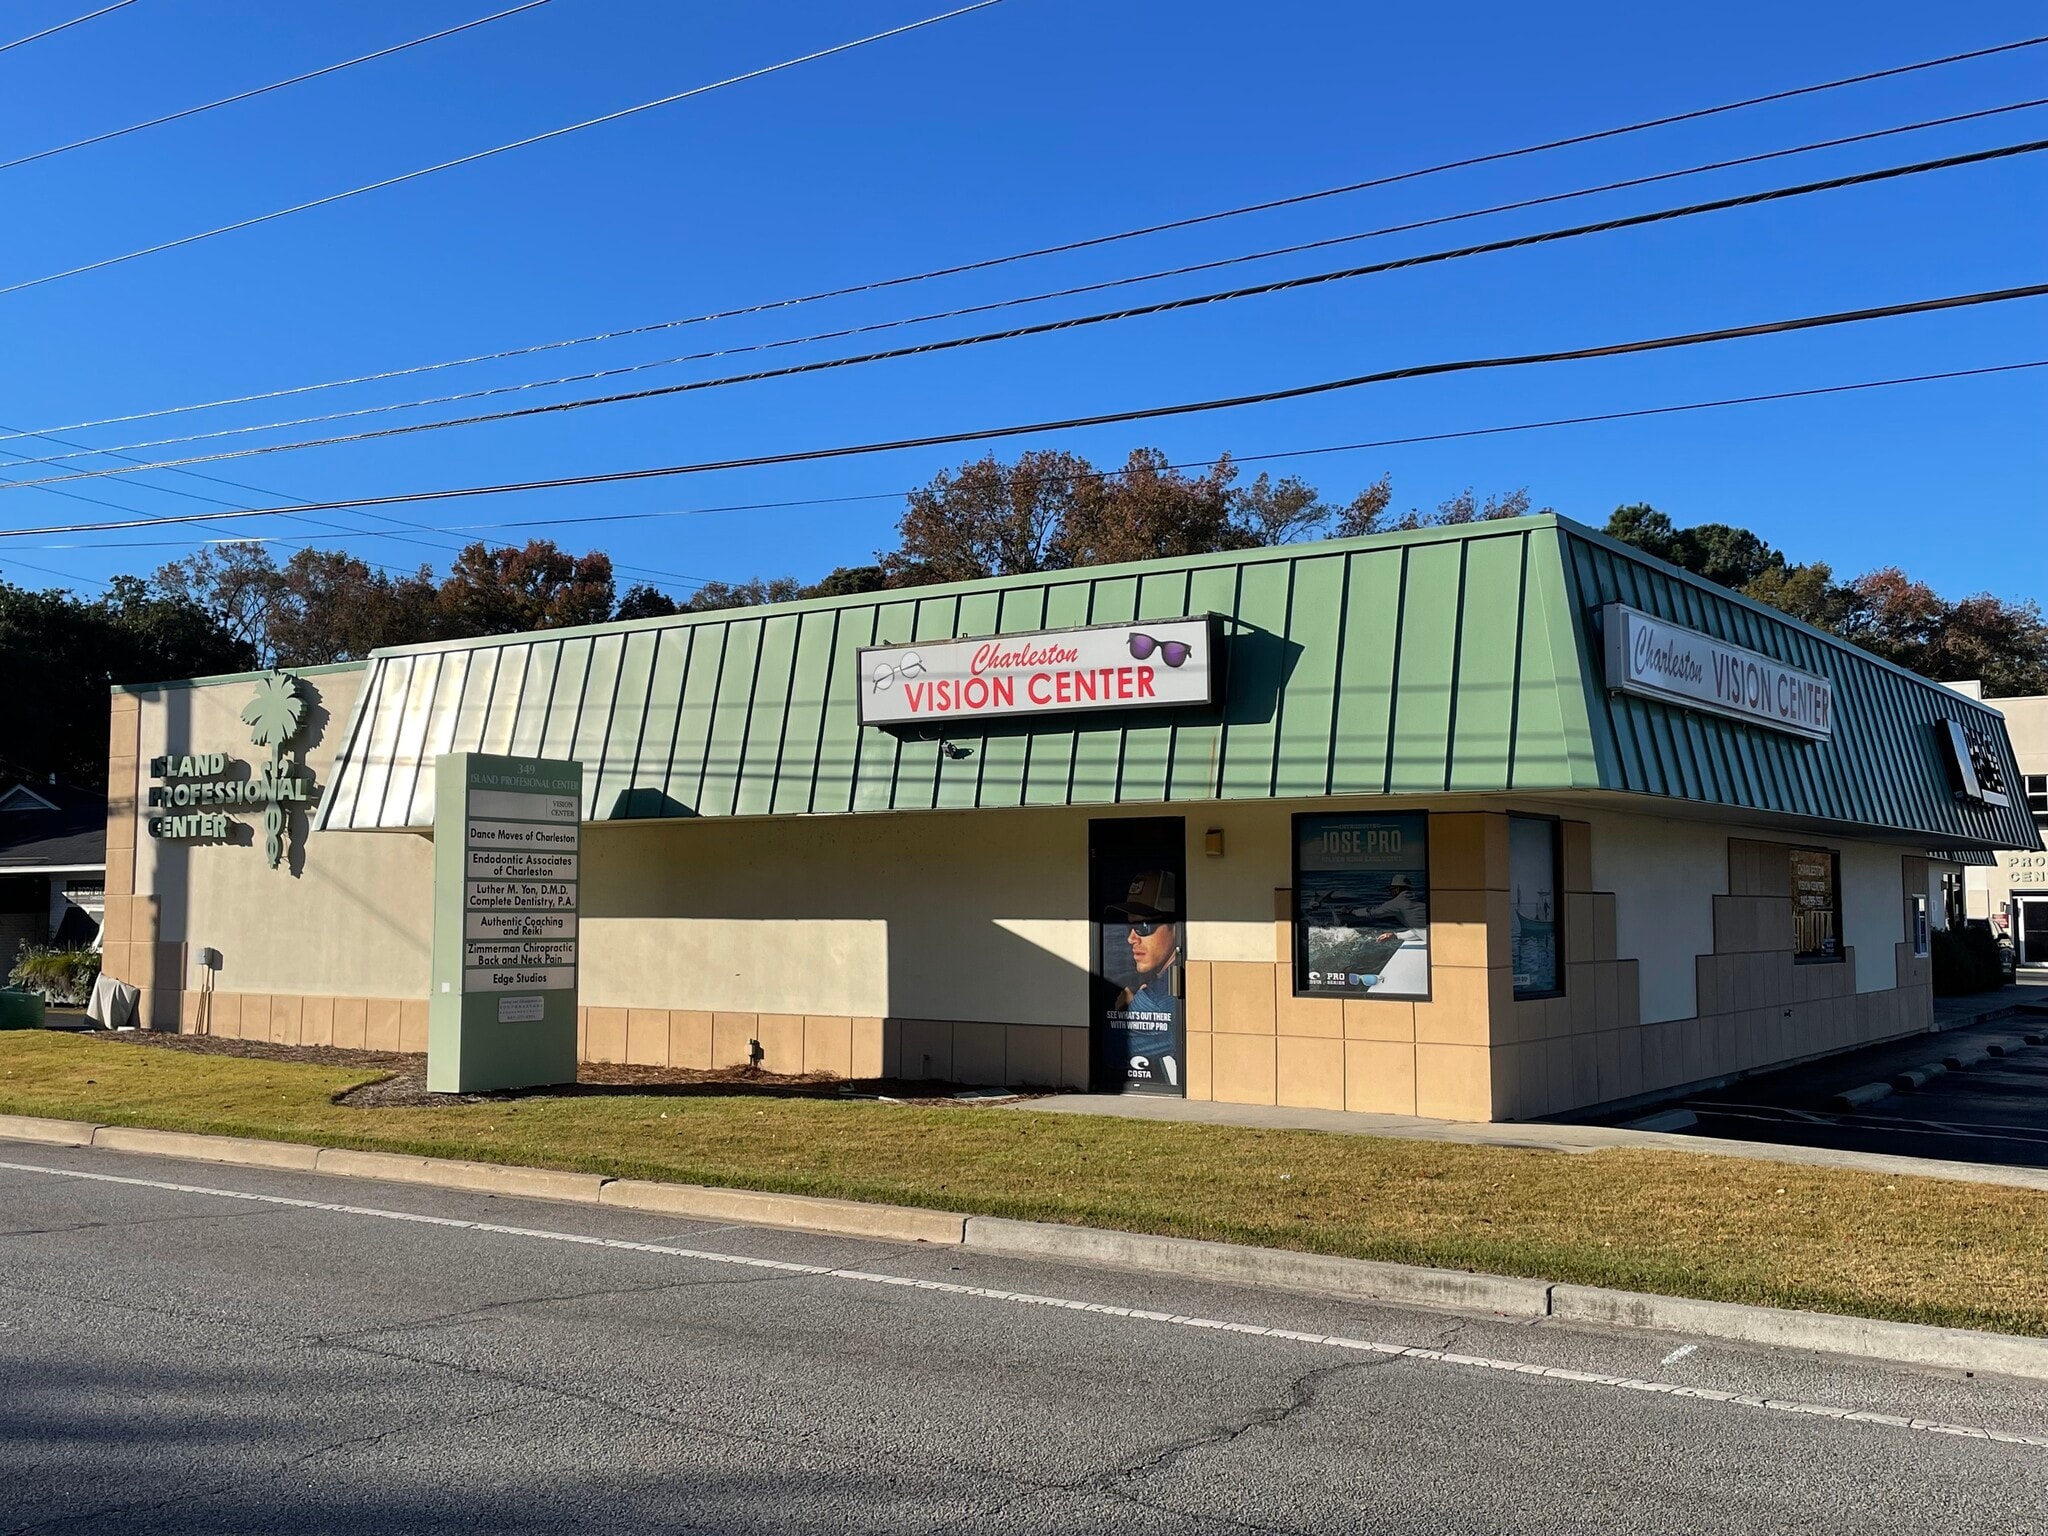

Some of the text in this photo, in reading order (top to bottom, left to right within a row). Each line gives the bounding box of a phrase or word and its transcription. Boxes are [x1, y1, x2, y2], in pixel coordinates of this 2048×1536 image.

[970, 643, 1079, 676] Charleston
[1634, 625, 1829, 729] Charleston VISION CENTER
[904, 665, 1156, 712] VISION CENTER
[150, 754, 226, 778] ISLAND
[517, 764, 536, 775] 349
[470, 774, 499, 785] ISLAND
[552, 779, 579, 791] CENTER
[148, 779, 308, 807] PROFESSIONAL
[552, 800, 574, 808] VISION
[551, 809, 575, 817] CENTER
[148, 814, 227, 838] CENTER
[470, 828, 575, 843] Dance Moves of Charleston
[1321, 830, 1402, 854] JOSE PRO
[473, 853, 572, 866] Endodontic Associates
[2008, 856, 2048, 868] PRO
[493, 865, 553, 876] of Charleston
[2009, 871, 2048, 882] CEN
[477, 884, 568, 897] Luther M. Yon, D.M.D.
[469, 896, 574, 909] Complete Dentistry, P.A.
[481, 916, 563, 928] Authentic Coaching
[503, 926, 542, 935] and Reiki
[468, 943, 573, 955] Zimmerman Chiropractic
[478, 954, 562, 965] Back and Neck Pain
[493, 973, 547, 985] Edge Studios
[1326, 972, 1345, 980] PRO
[1106, 1010, 1172, 1021] SEE WHAT'S OUT THERE
[1110, 1020, 1168, 1031] WITH WHITETIP PRO
[1127, 1070, 1152, 1078] COSTA
